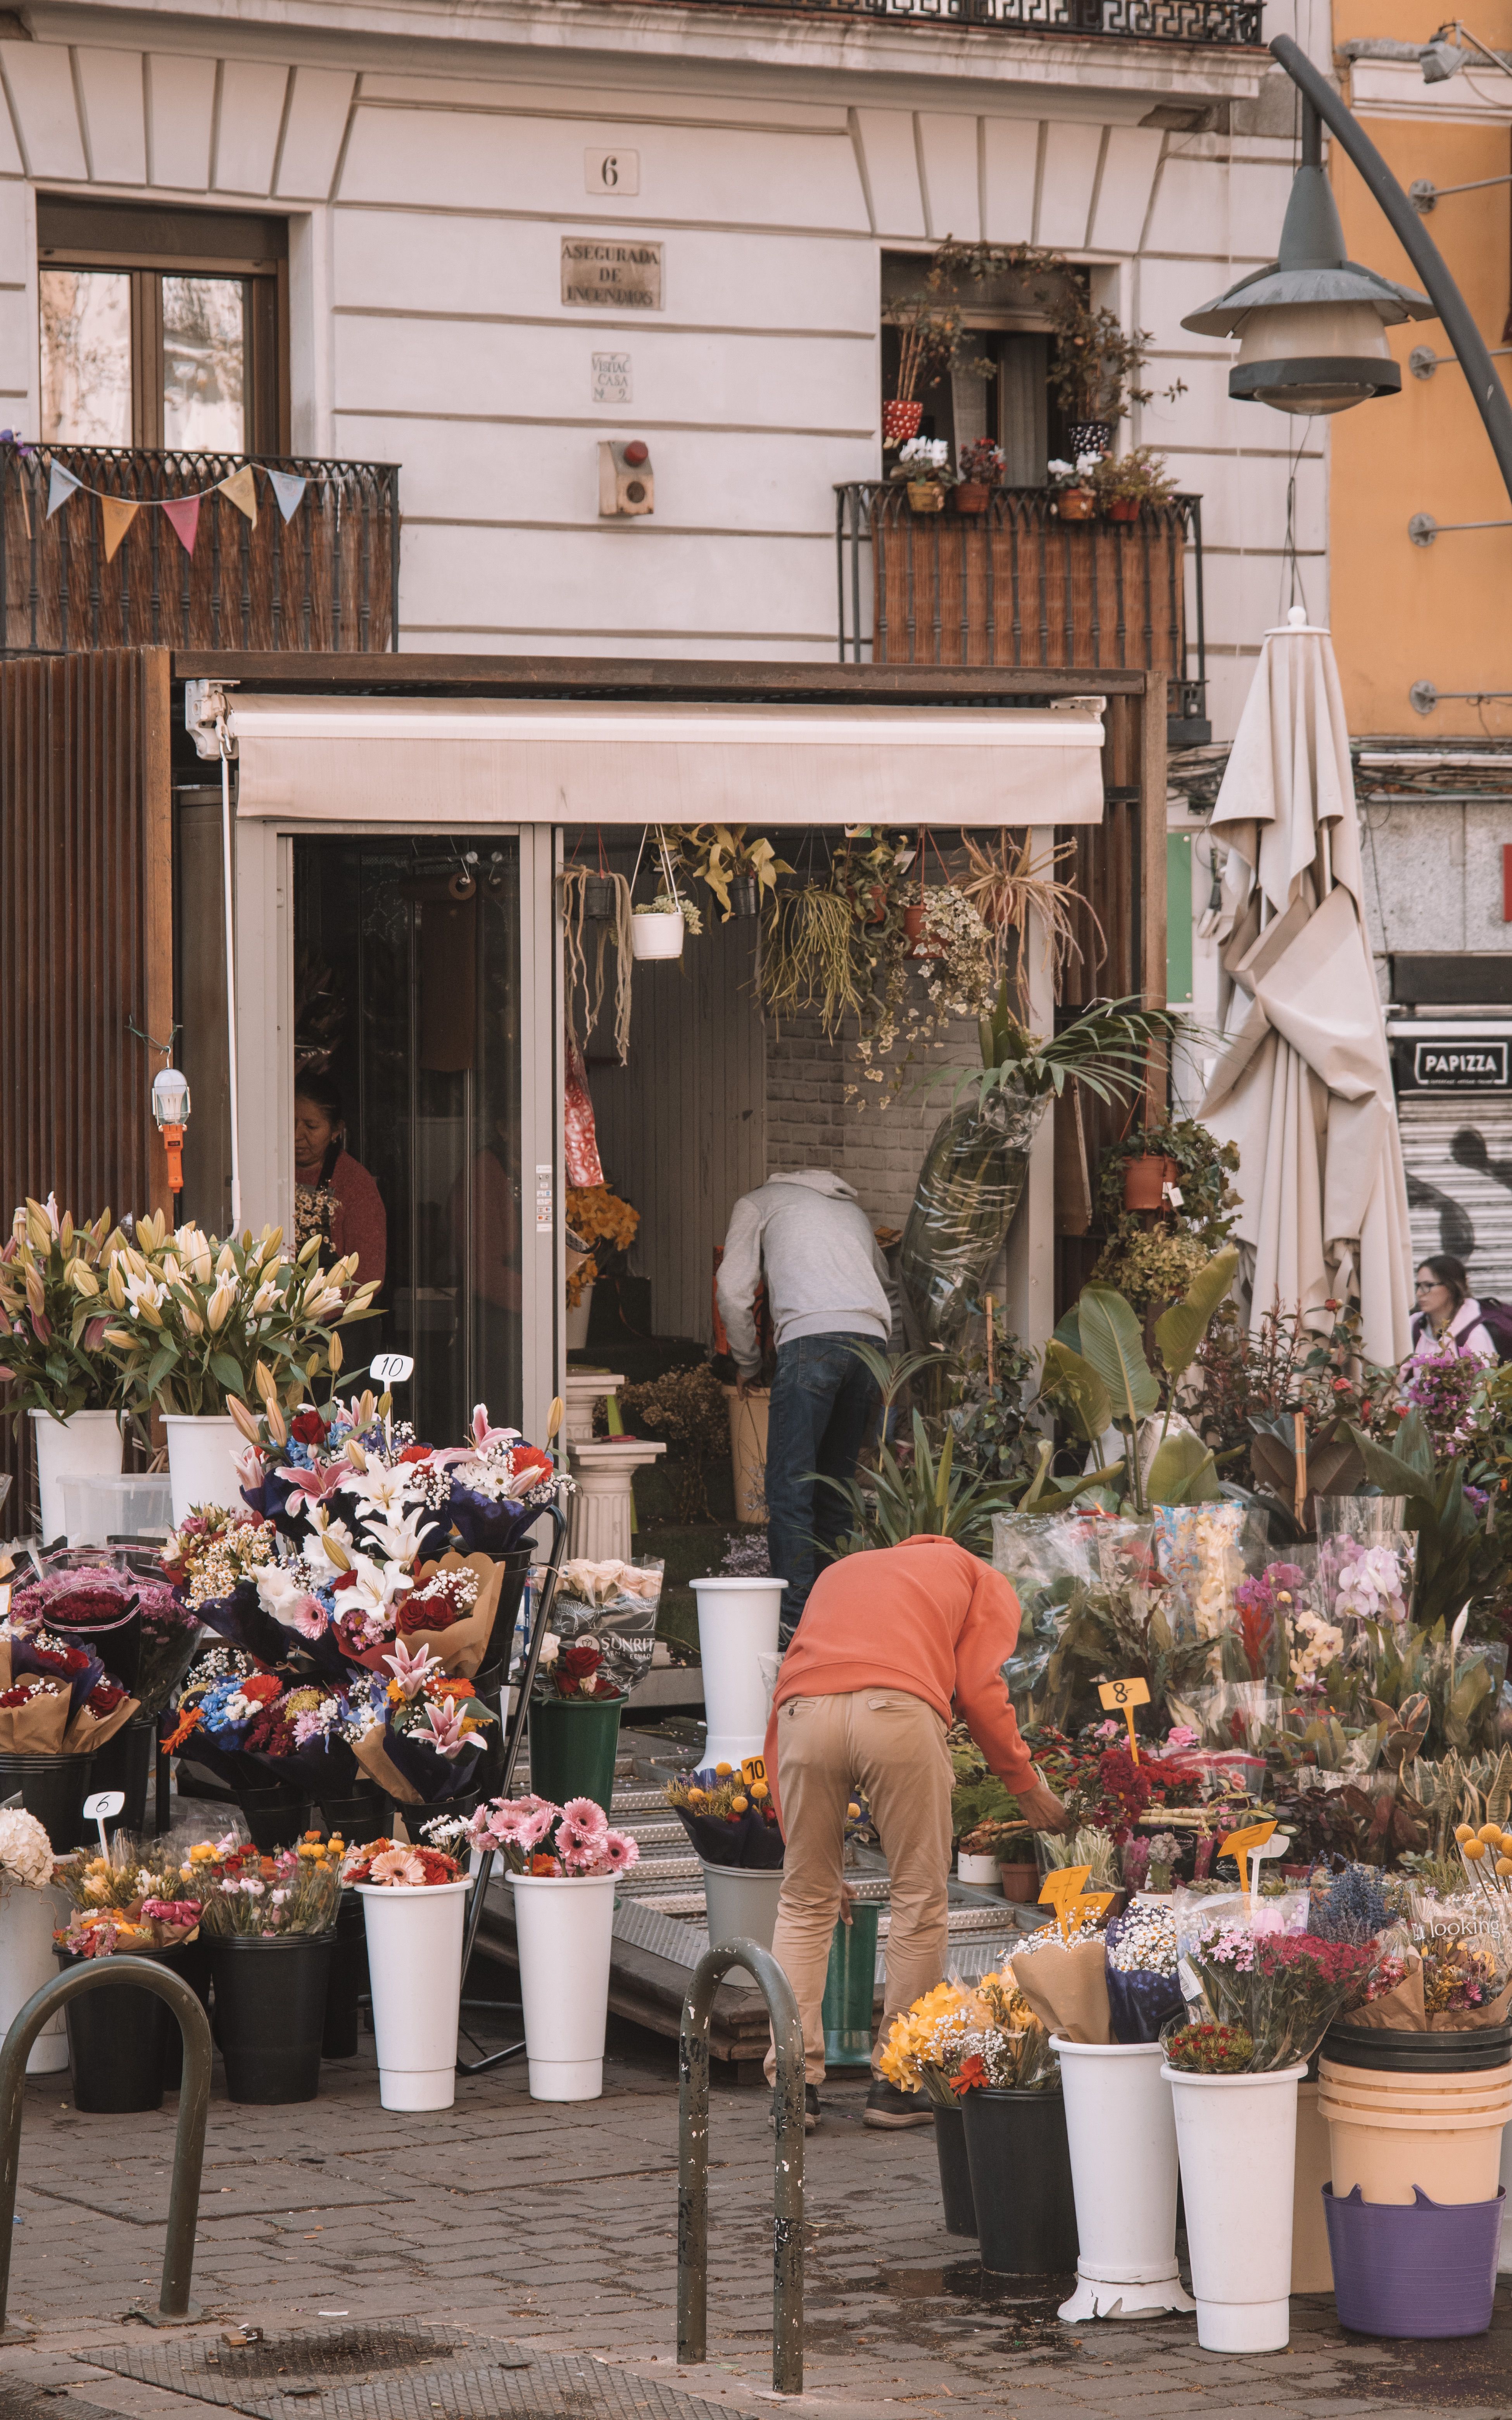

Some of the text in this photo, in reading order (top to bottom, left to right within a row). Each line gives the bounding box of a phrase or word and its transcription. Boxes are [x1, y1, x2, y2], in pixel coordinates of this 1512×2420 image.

[602, 156, 618, 185] 6
[563, 245, 659, 264] ASEGURADA
[599, 267, 621, 282] DE
[1425, 1055, 1497, 1072] PAPIZZA
[381, 1357, 403, 1377] 10
[601, 1637, 655, 1652] SUNRIT
[746, 1760, 765, 1780] 10
[96, 1795, 110, 1812] 6
